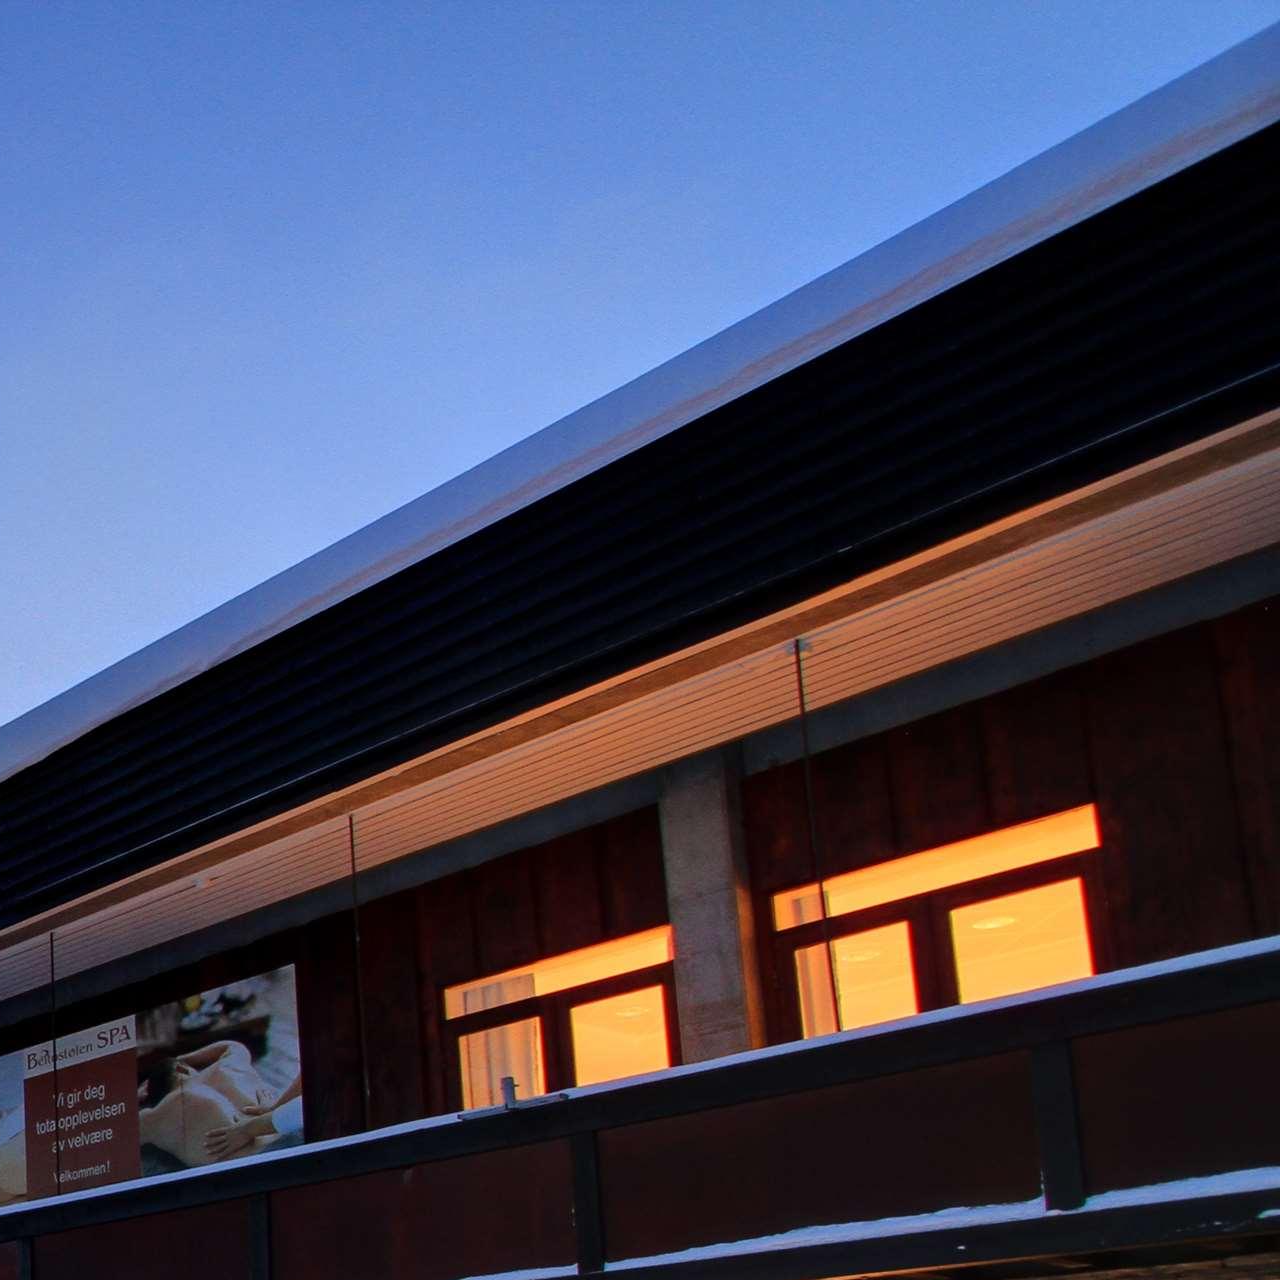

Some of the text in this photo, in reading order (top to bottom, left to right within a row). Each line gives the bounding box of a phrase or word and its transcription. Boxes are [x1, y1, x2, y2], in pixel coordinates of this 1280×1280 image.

[96, 1025, 130, 1049] SPA
[67, 1089, 81, 1108] gir
[84, 1085, 105, 1101] deg
[36, 1102, 126, 1135] tota opplevelsen
[67, 1128, 112, 1149] velvære
